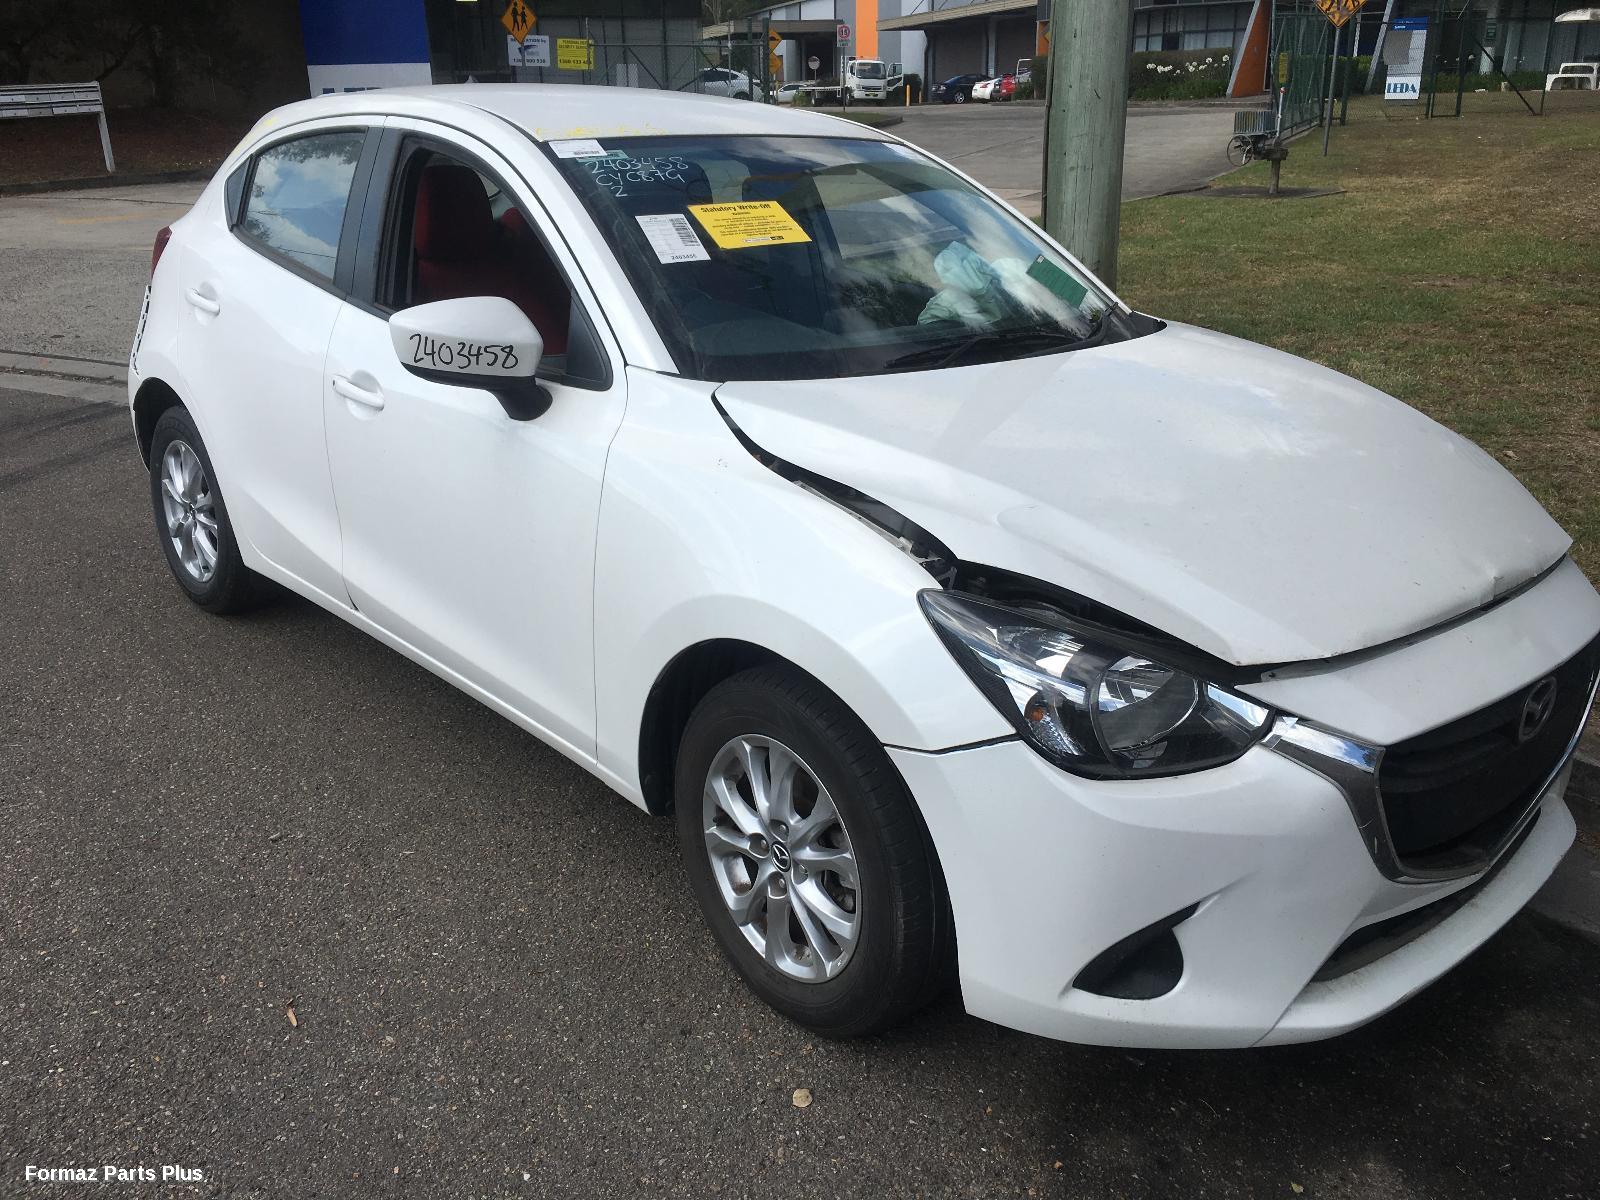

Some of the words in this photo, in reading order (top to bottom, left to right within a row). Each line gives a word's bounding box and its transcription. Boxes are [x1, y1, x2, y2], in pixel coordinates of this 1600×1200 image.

[1386, 83, 1416, 93] LEDA
[585, 156, 689, 173] 2403458
[737, 203, 771, 212] Write-Off
[409, 333, 519, 369] 2403458
